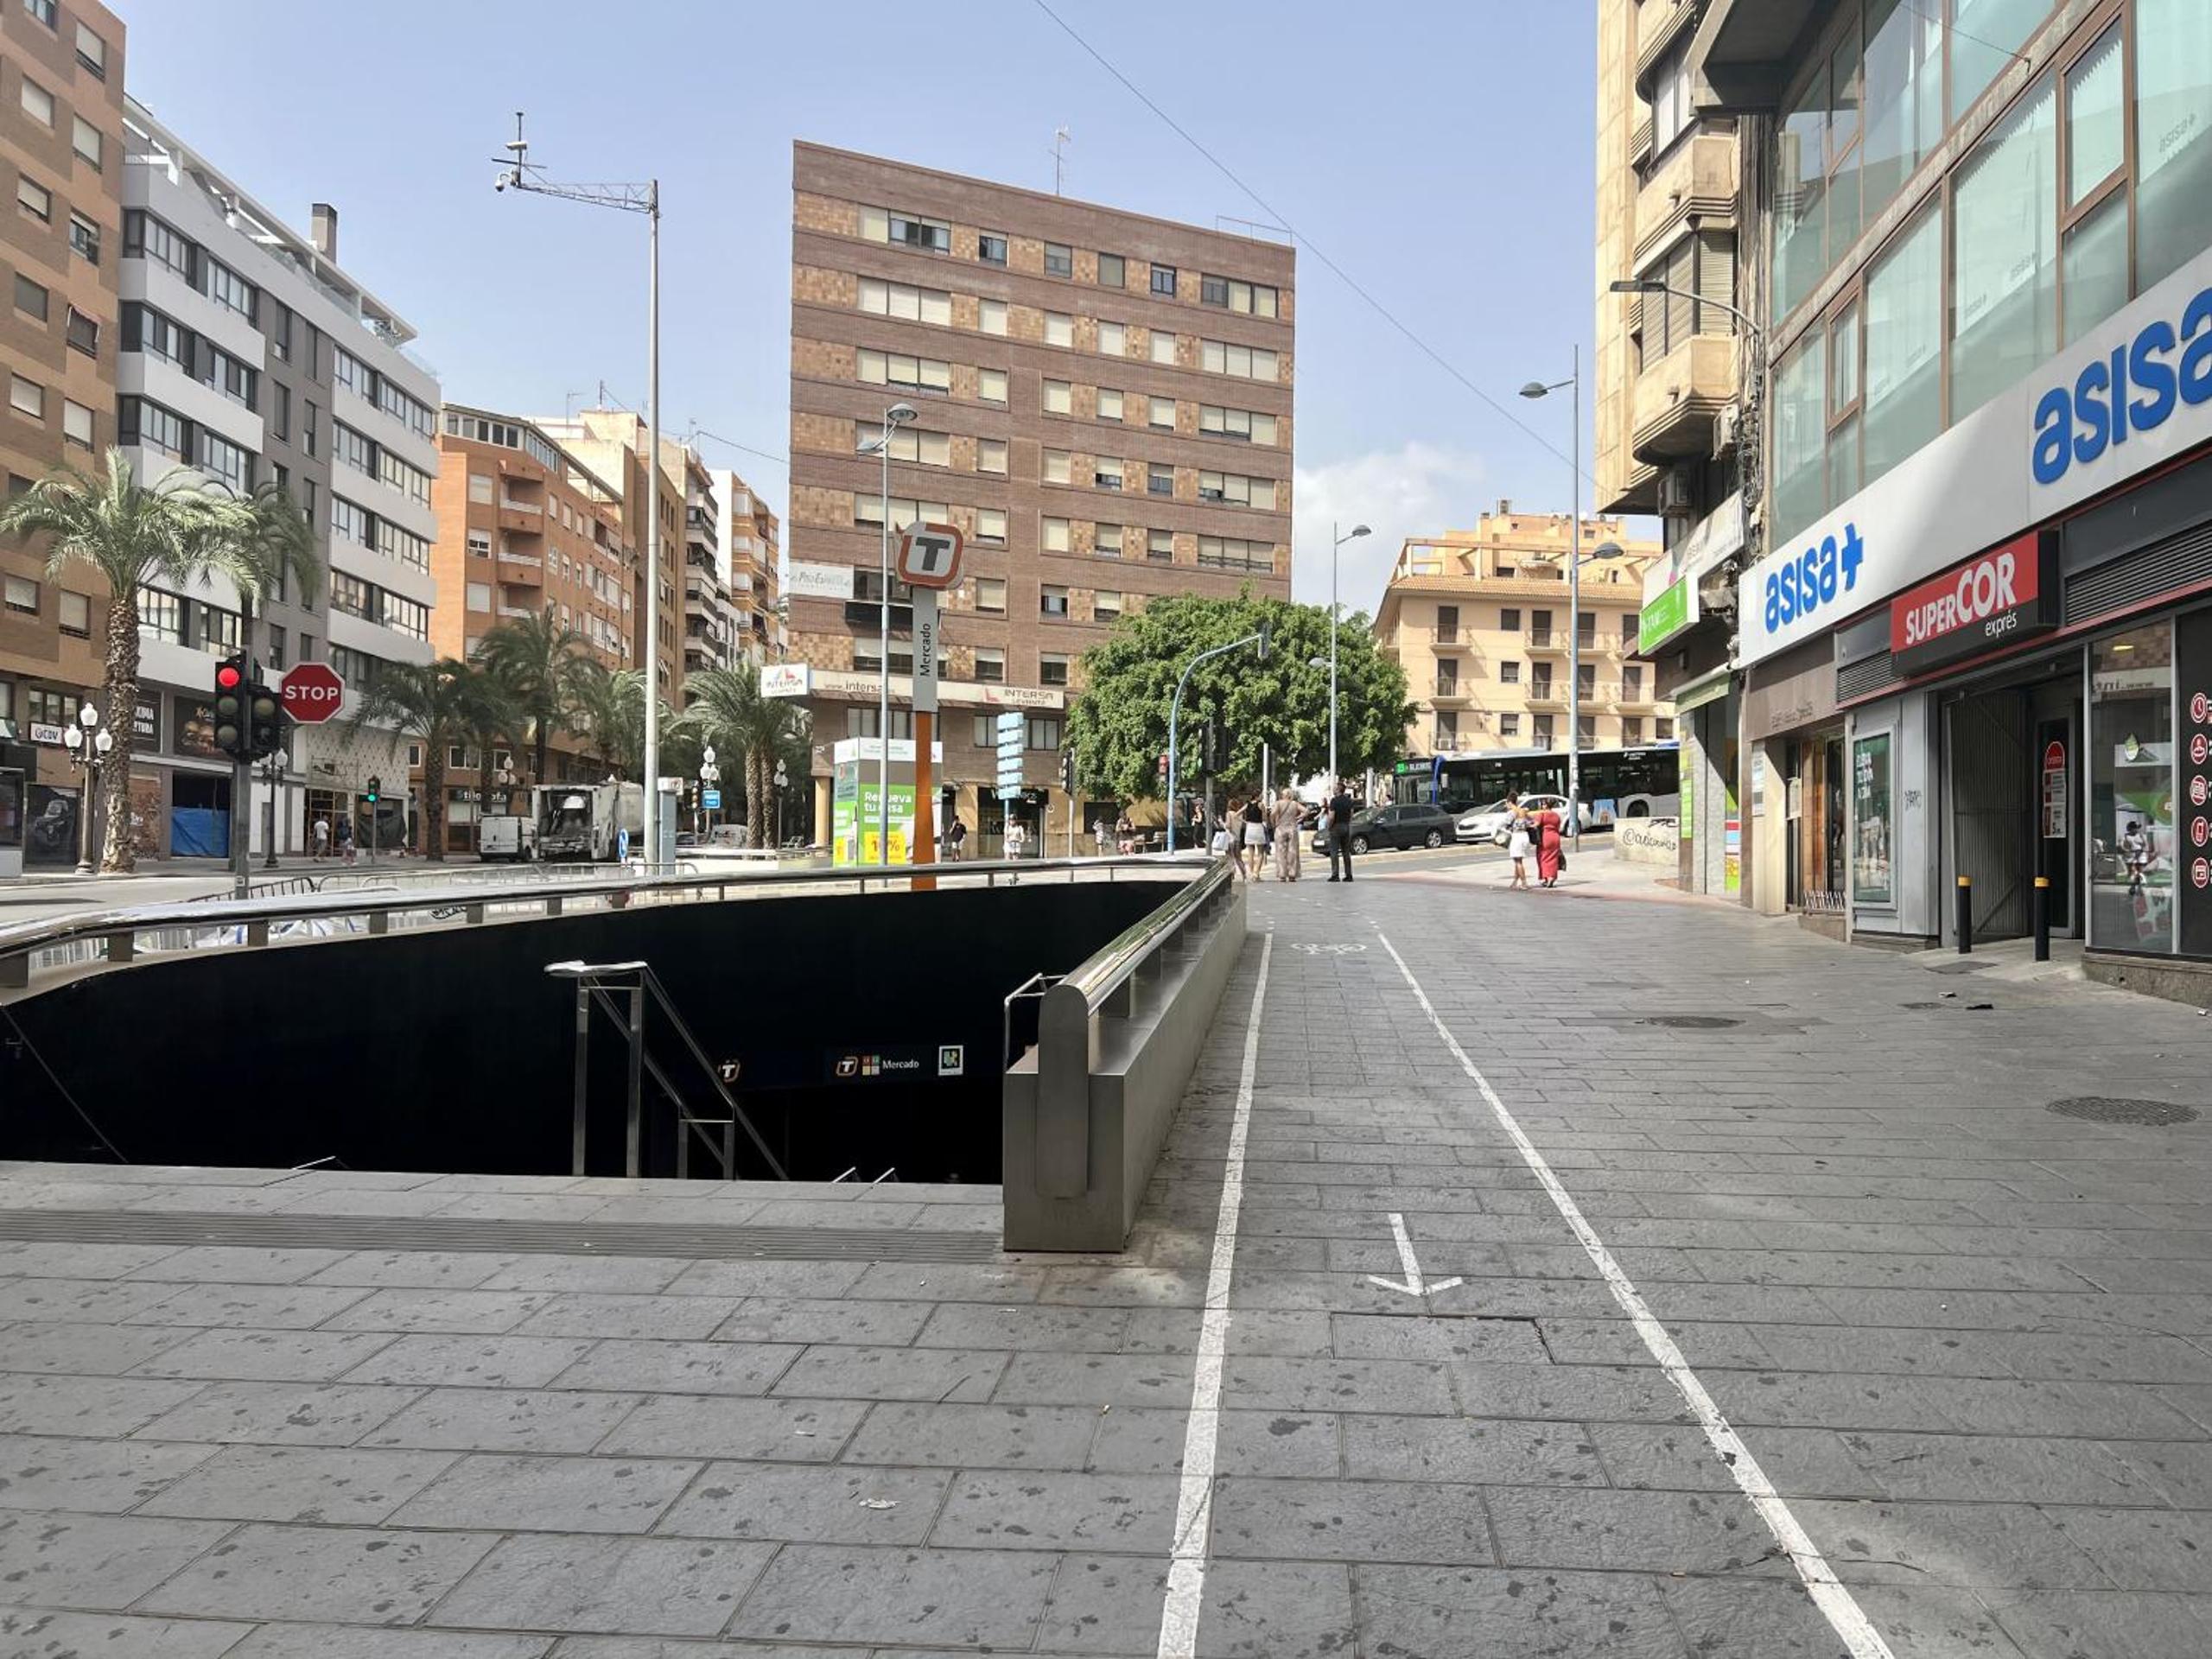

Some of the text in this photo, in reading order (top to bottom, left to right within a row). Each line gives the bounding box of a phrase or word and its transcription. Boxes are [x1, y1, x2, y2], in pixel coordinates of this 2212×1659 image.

[1986, 610, 2018, 638] exprés
[920, 623, 931, 677] Mercado
[284, 685, 339, 701] STOP
[865, 791, 912, 804] Reueva
[882, 1058, 919, 1070] Mercado
